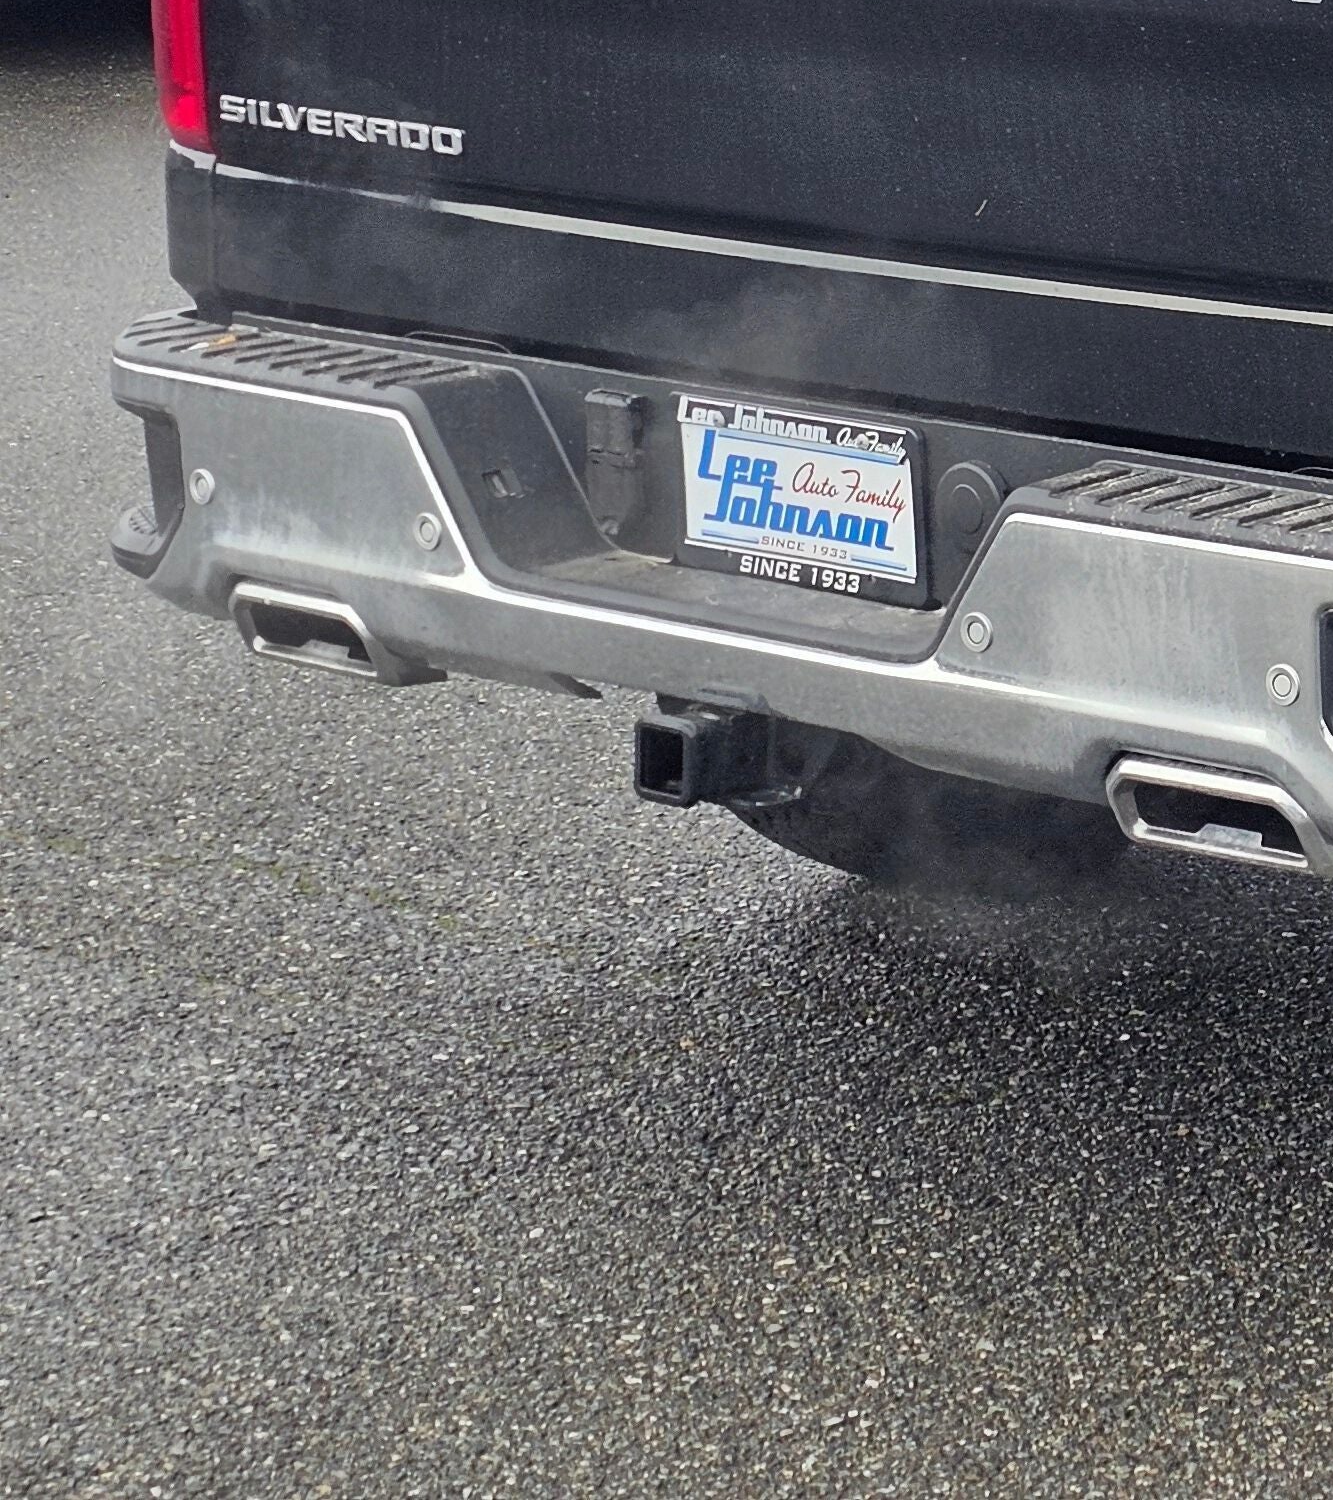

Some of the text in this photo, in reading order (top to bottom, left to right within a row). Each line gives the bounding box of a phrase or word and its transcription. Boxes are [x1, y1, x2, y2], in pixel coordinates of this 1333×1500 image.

[219, 94, 464, 156] SILVERADO
[727, 403, 832, 445] Johnson
[697, 429, 907, 524] Lee Auto Family
[703, 472, 895, 552] Johnson
[760, 535, 848, 560] SINCE 1933
[739, 555, 861, 594] SINCE 1933
